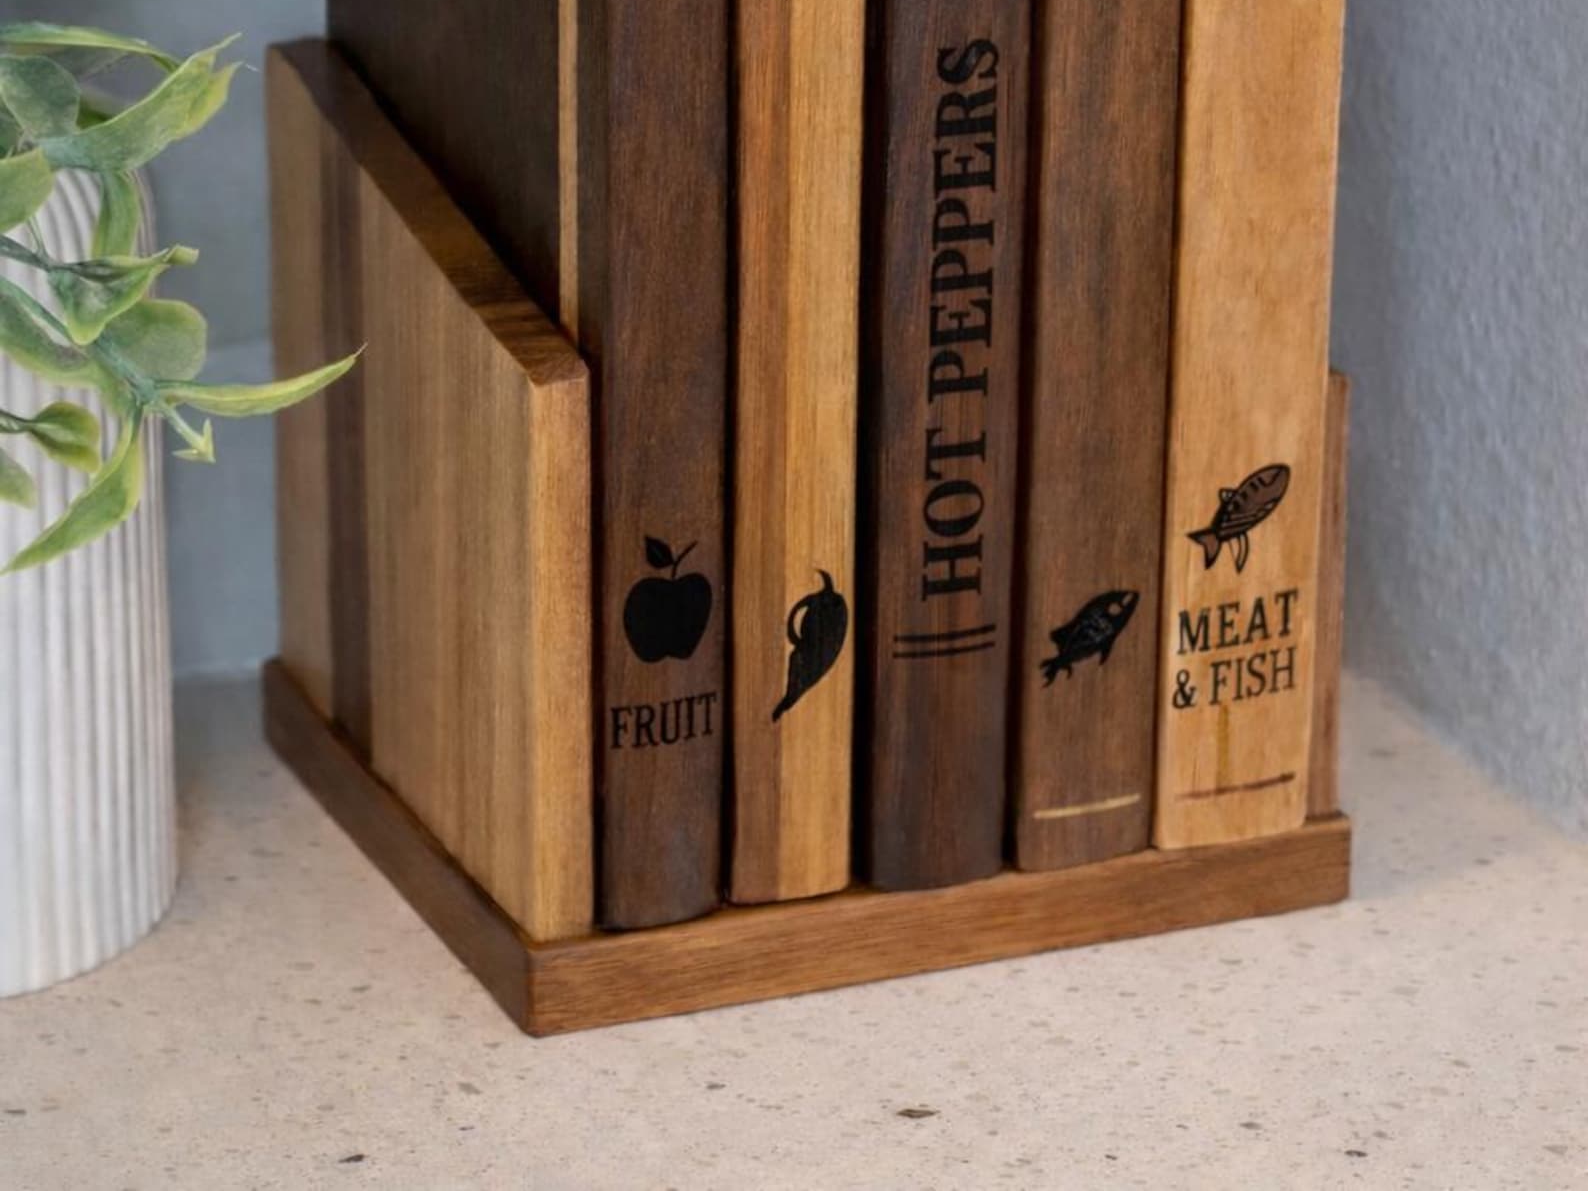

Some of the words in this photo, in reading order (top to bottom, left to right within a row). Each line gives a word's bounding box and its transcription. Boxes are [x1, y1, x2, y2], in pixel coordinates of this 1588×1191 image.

[928, 38, 999, 404] PEPPERS
[922, 428, 987, 602] HOT
[1177, 588, 1299, 655] MEAT
[1172, 669, 1197, 710] &
[1209, 646, 1297, 706] FISH
[610, 691, 717, 749] FRUIT
